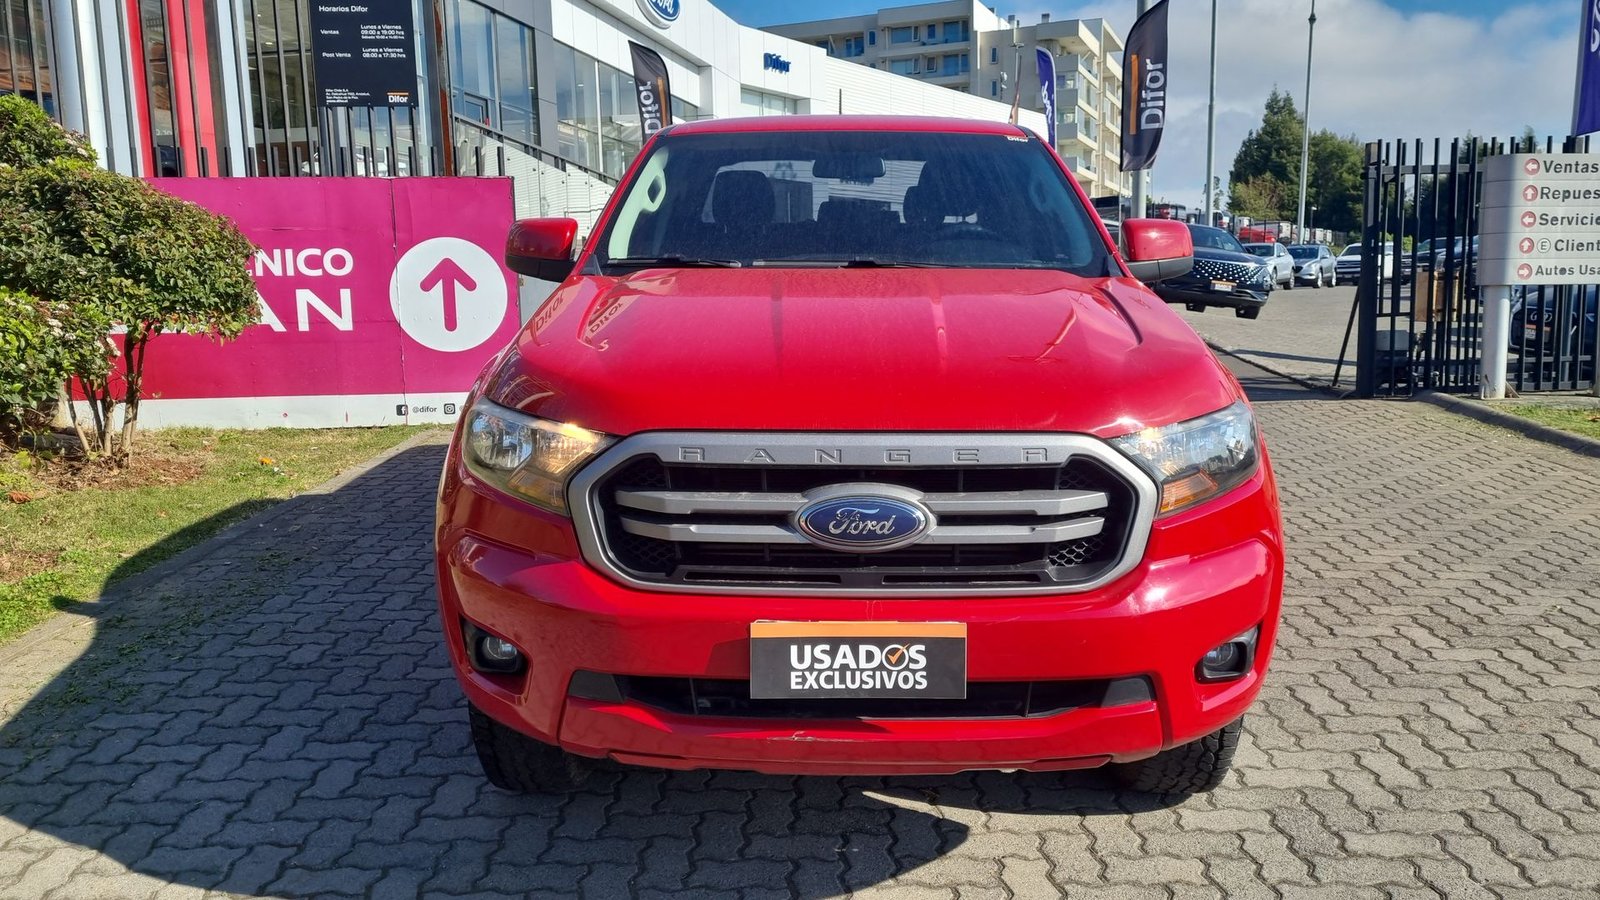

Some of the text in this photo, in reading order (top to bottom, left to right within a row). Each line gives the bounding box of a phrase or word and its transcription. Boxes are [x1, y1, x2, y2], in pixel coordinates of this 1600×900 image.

[763, 52, 792, 75] Difor
[388, 95, 408, 103] Difor
[1140, 58, 1166, 131] Difor
[638, 81, 662, 135] Difor
[1543, 160, 1599, 174] Ventas
[249, 247, 354, 277] NICO
[1535, 265, 1575, 276] Autos
[412, 405, 437, 413] @difor
[678, 446, 1048, 464] RANGER
[828, 507, 896, 535] Ford
[790, 643, 927, 670] USADOS
[790, 671, 928, 690] EXCLUSIVOS
